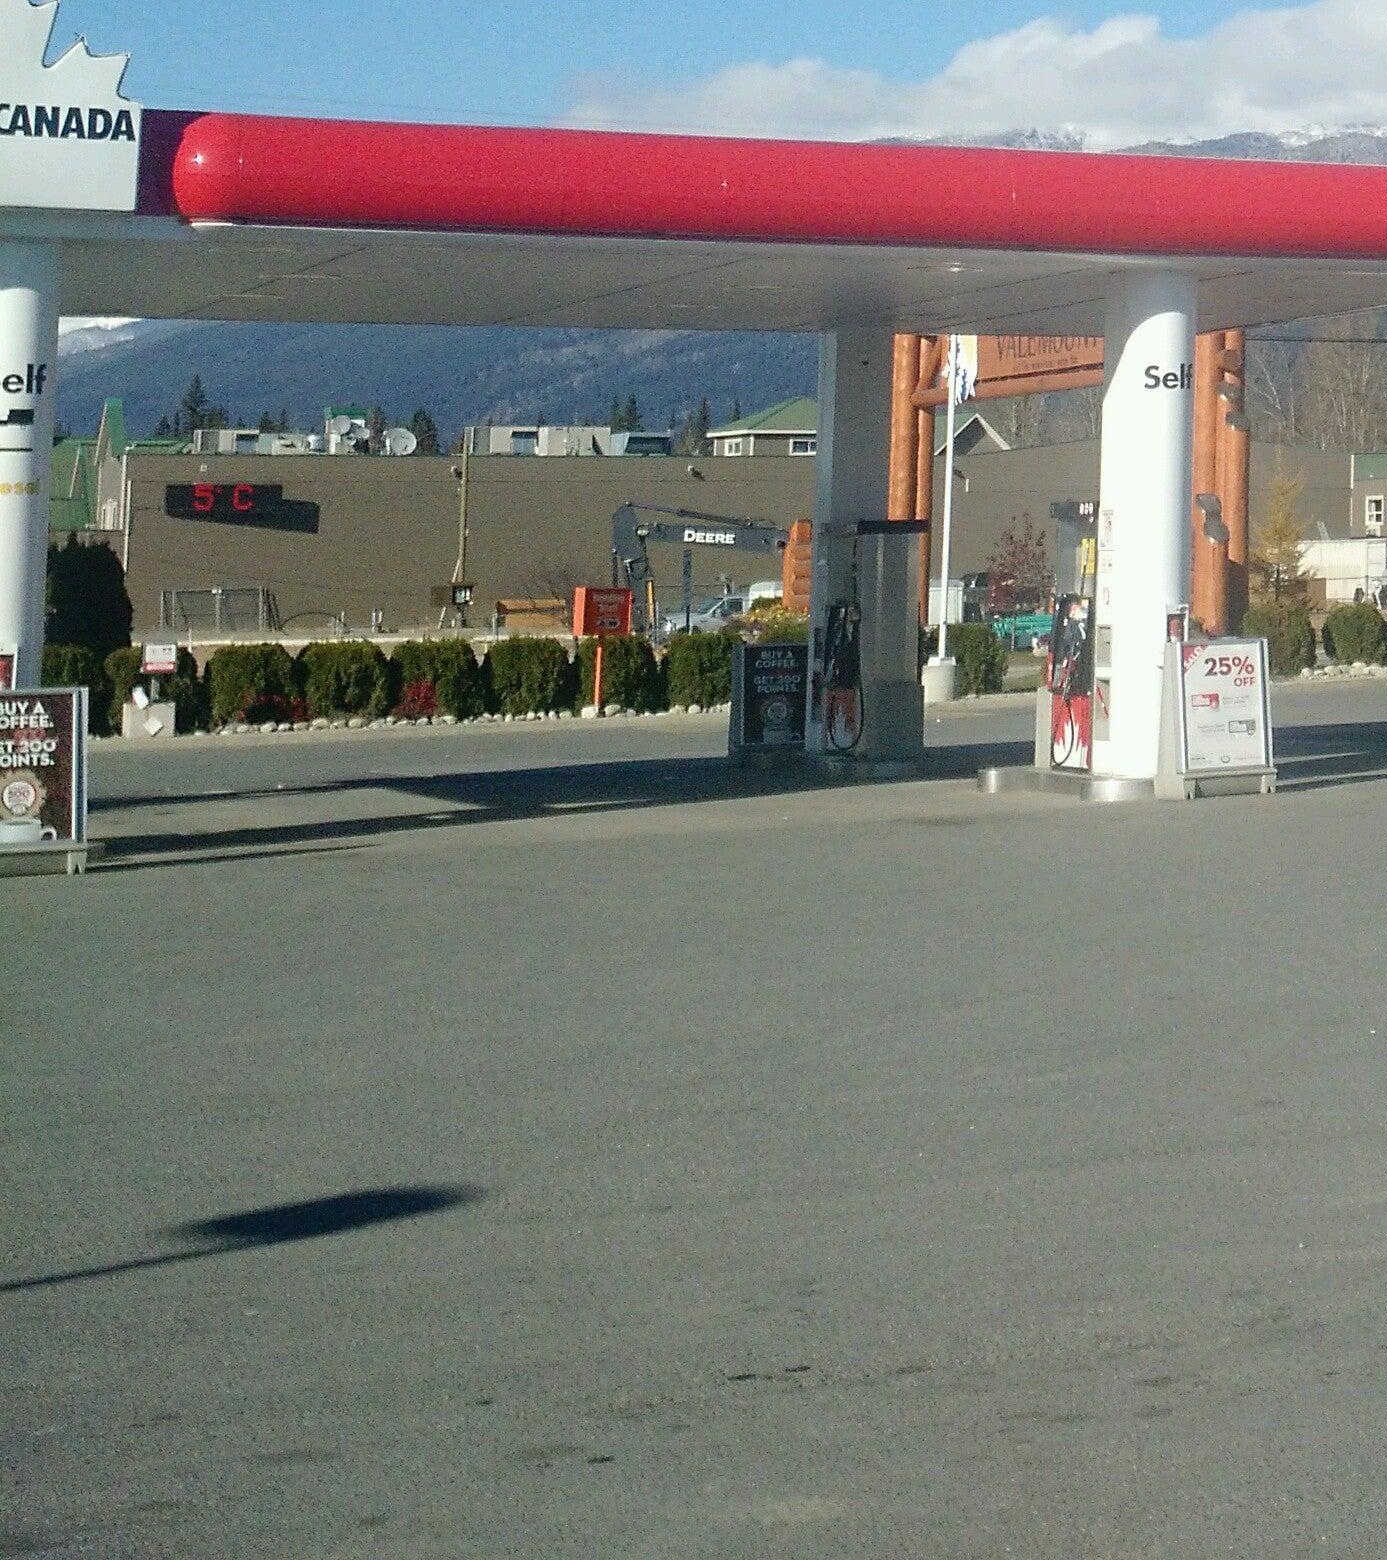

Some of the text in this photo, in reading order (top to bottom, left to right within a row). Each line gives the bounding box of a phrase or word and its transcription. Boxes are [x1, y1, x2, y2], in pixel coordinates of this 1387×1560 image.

[1204, 656, 1255, 677] 25%
[1234, 677, 1255, 688] OFF
[33, 700, 45, 714] A
